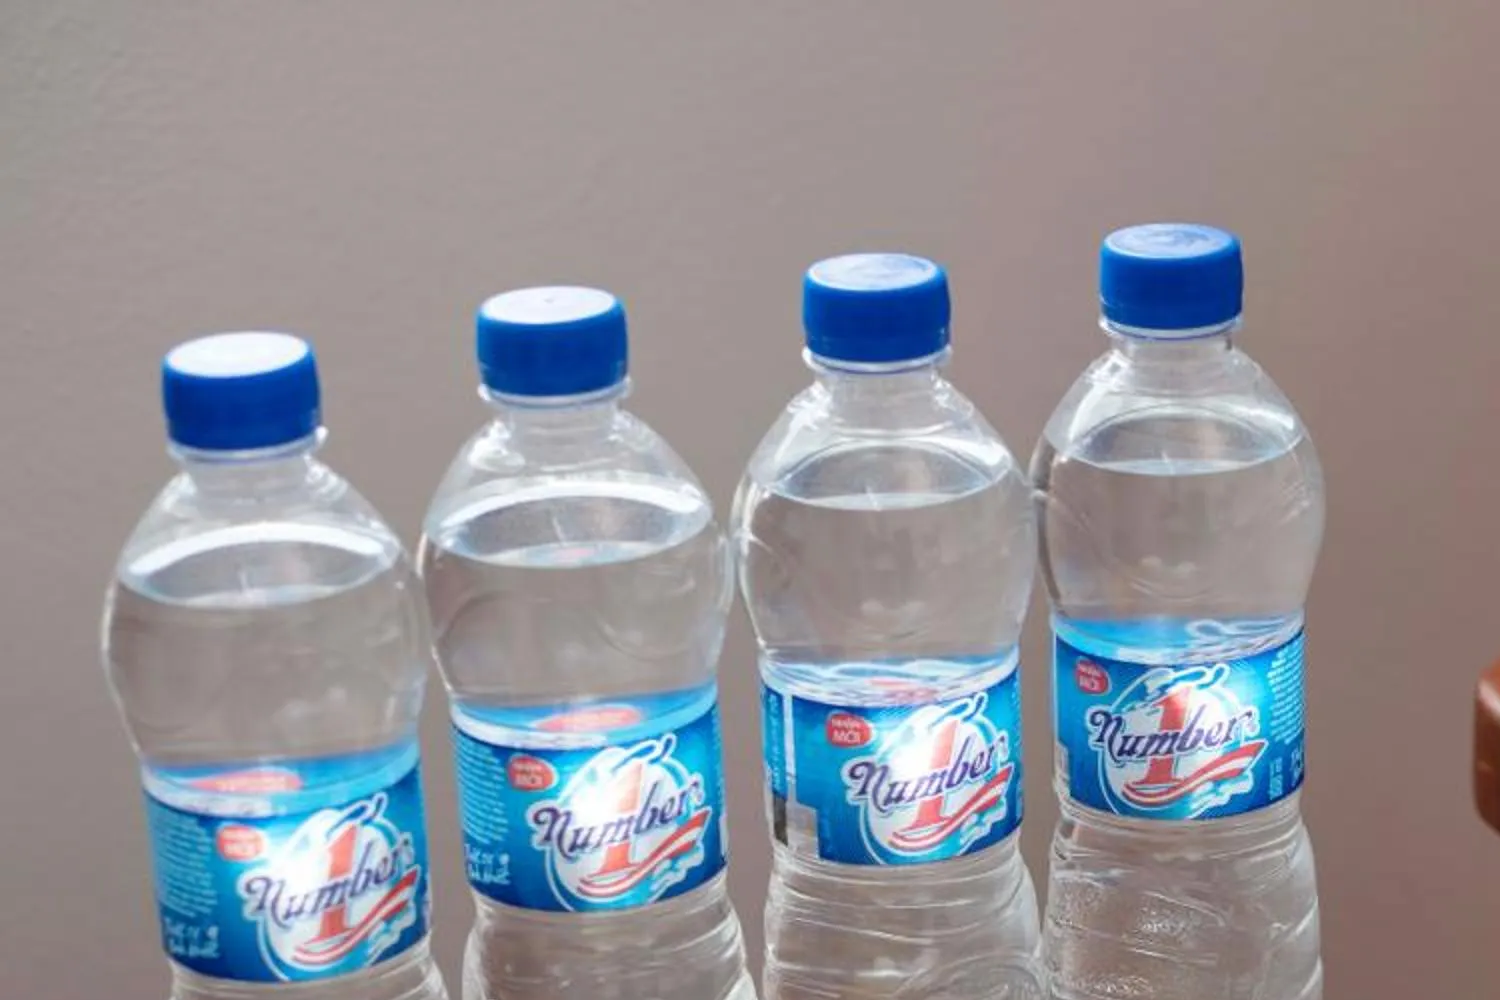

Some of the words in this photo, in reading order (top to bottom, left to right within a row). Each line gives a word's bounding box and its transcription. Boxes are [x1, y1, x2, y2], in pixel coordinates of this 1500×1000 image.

[849, 735, 1005, 814] Number
[1090, 704, 1253, 768] Number
[533, 781, 698, 860] Number
[245, 838, 409, 929] Number
